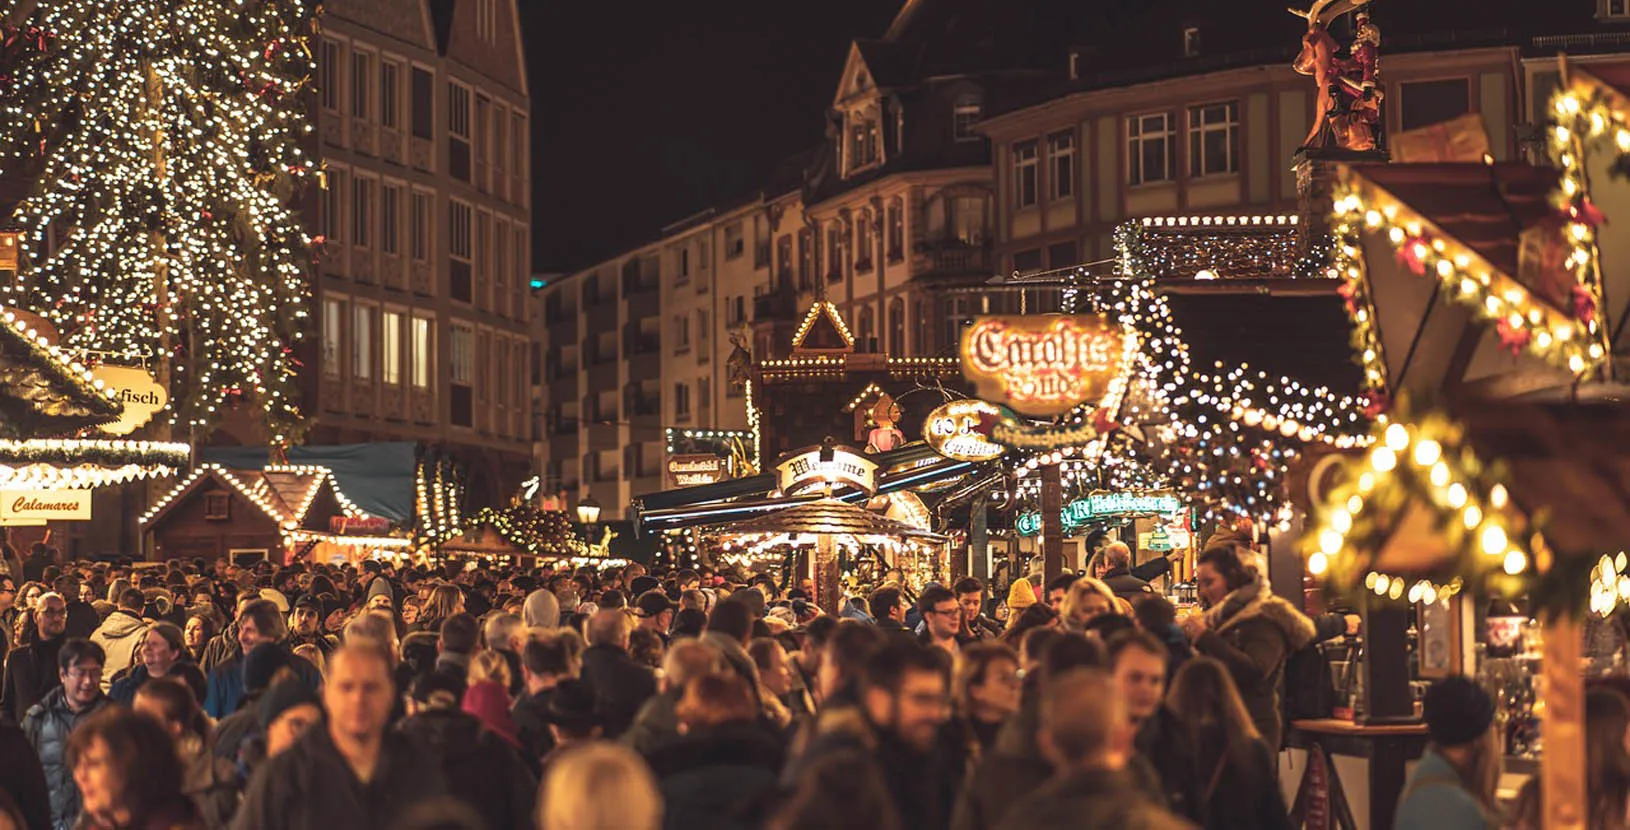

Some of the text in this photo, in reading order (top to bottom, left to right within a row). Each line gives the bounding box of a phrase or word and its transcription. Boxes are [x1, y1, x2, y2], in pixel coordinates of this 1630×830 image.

[113, 387, 159, 405] fisch
[788, 457, 866, 481] Weome
[12, 496, 80, 513] Calamares
